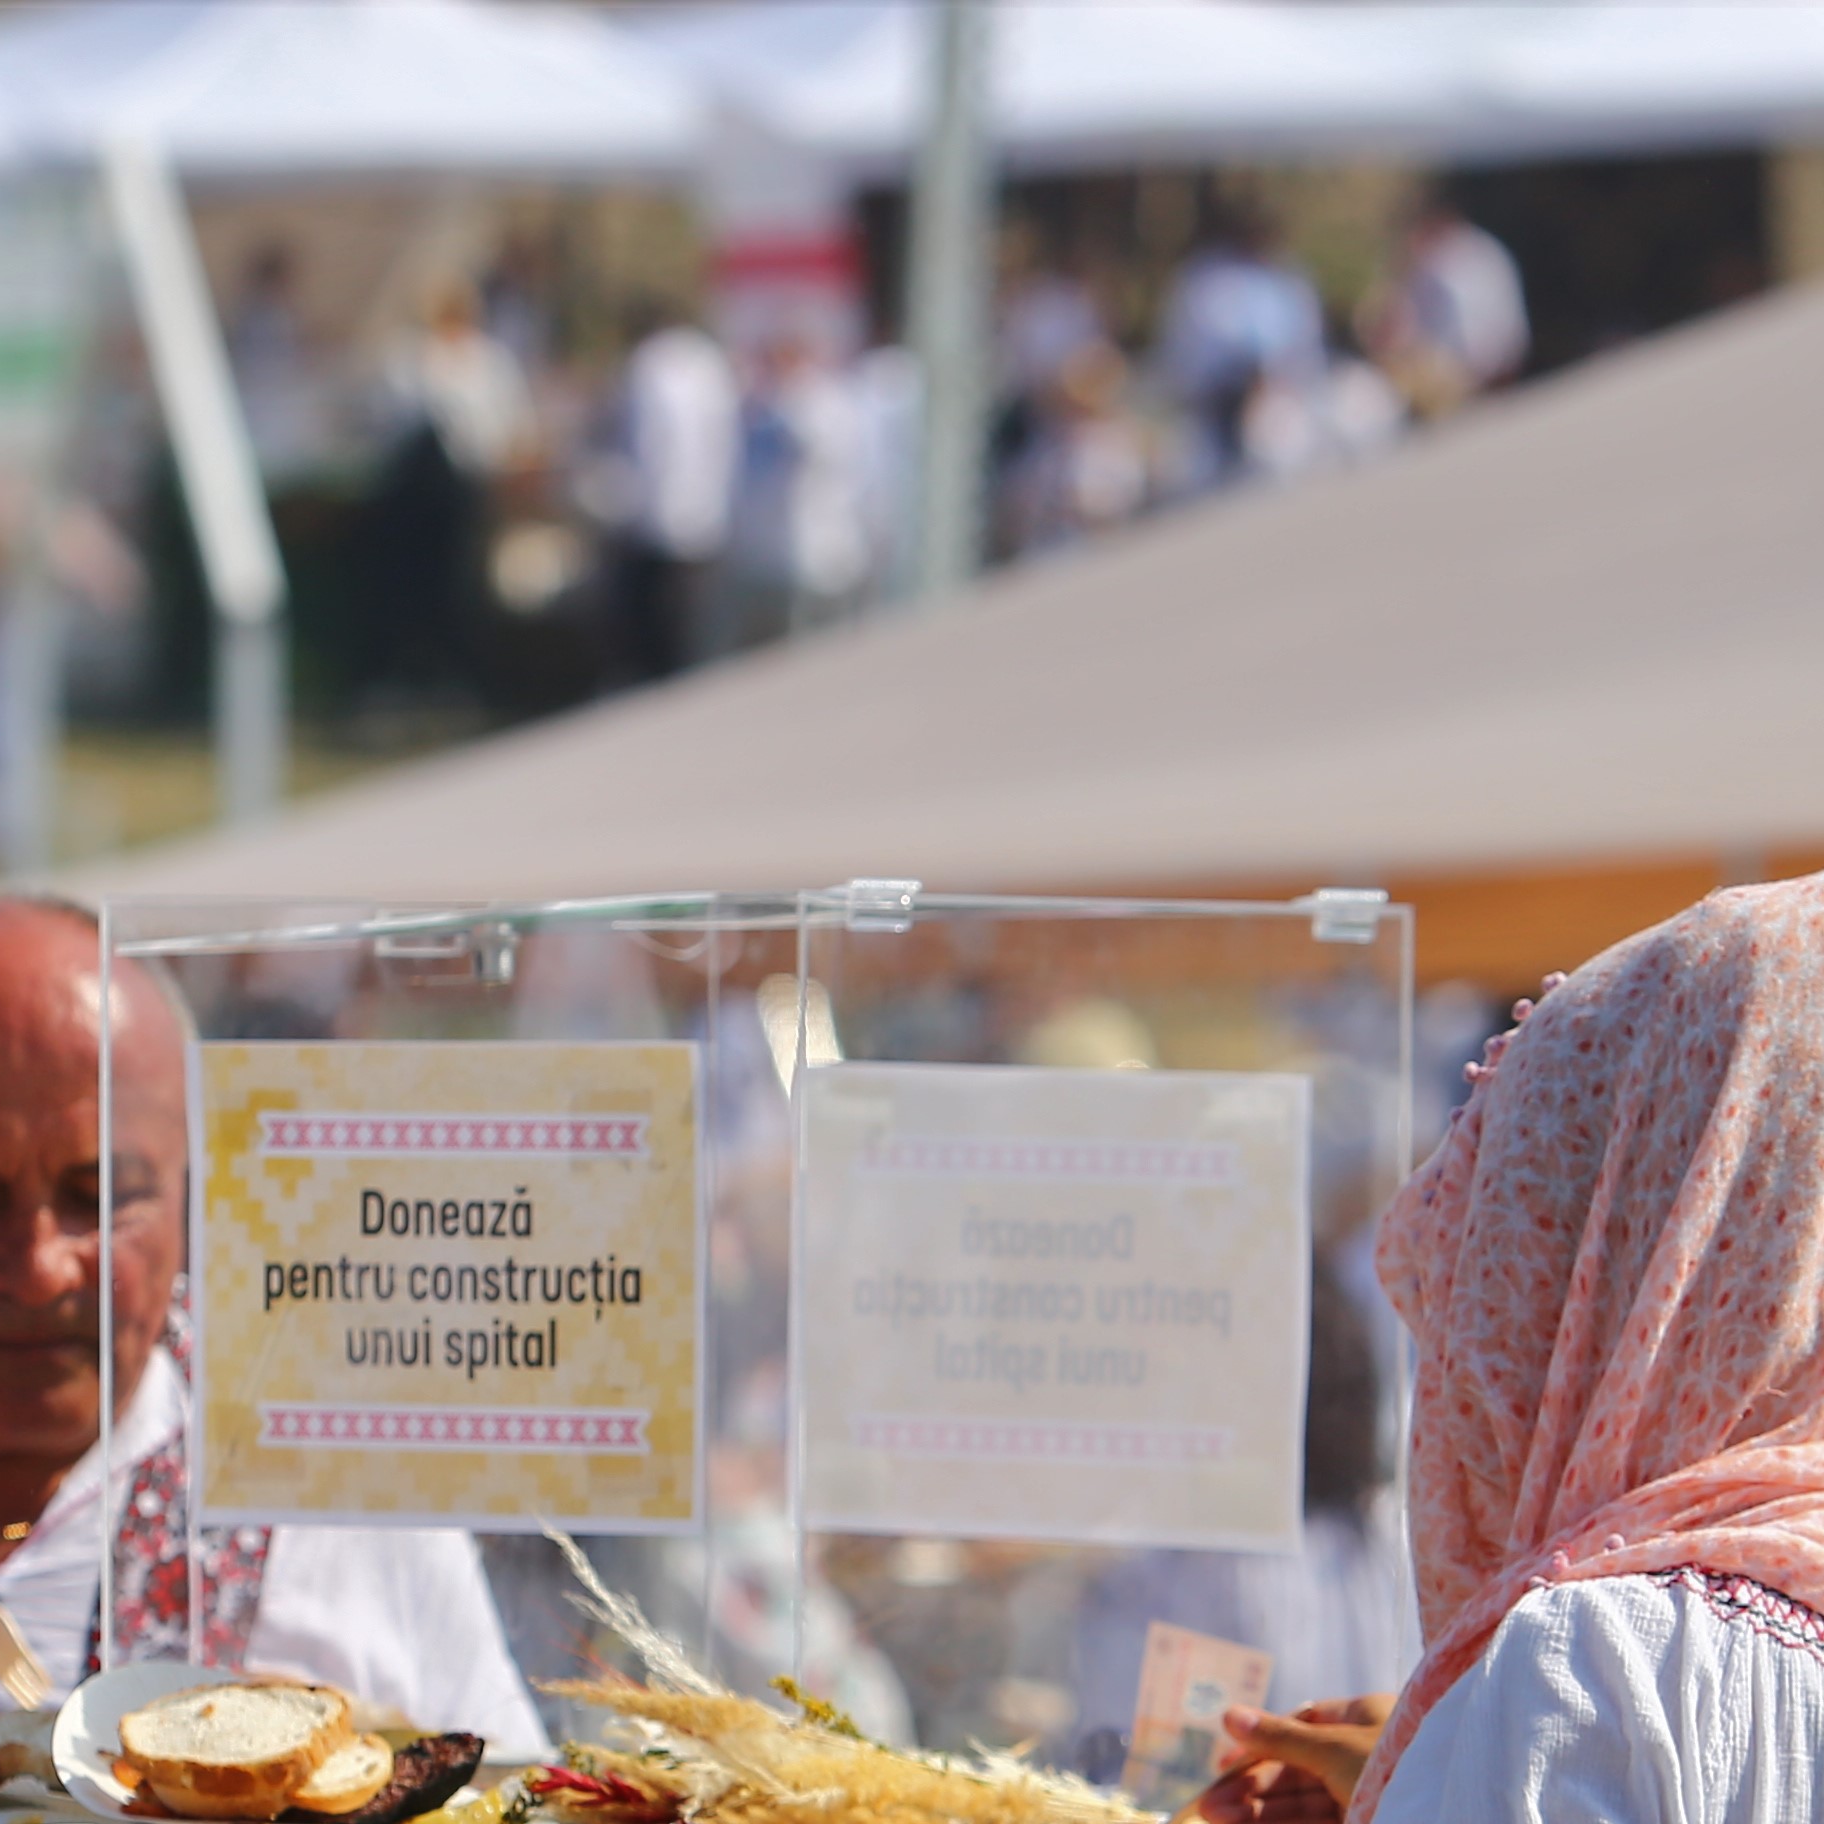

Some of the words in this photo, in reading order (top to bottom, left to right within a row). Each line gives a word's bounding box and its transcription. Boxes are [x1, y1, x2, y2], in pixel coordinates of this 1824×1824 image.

[360, 1184, 533, 1238] Donează
[263, 1256, 395, 1311] pentru
[407, 1255, 642, 1322] construcția
[345, 1318, 431, 1368] unui
[444, 1318, 557, 1379] spital
